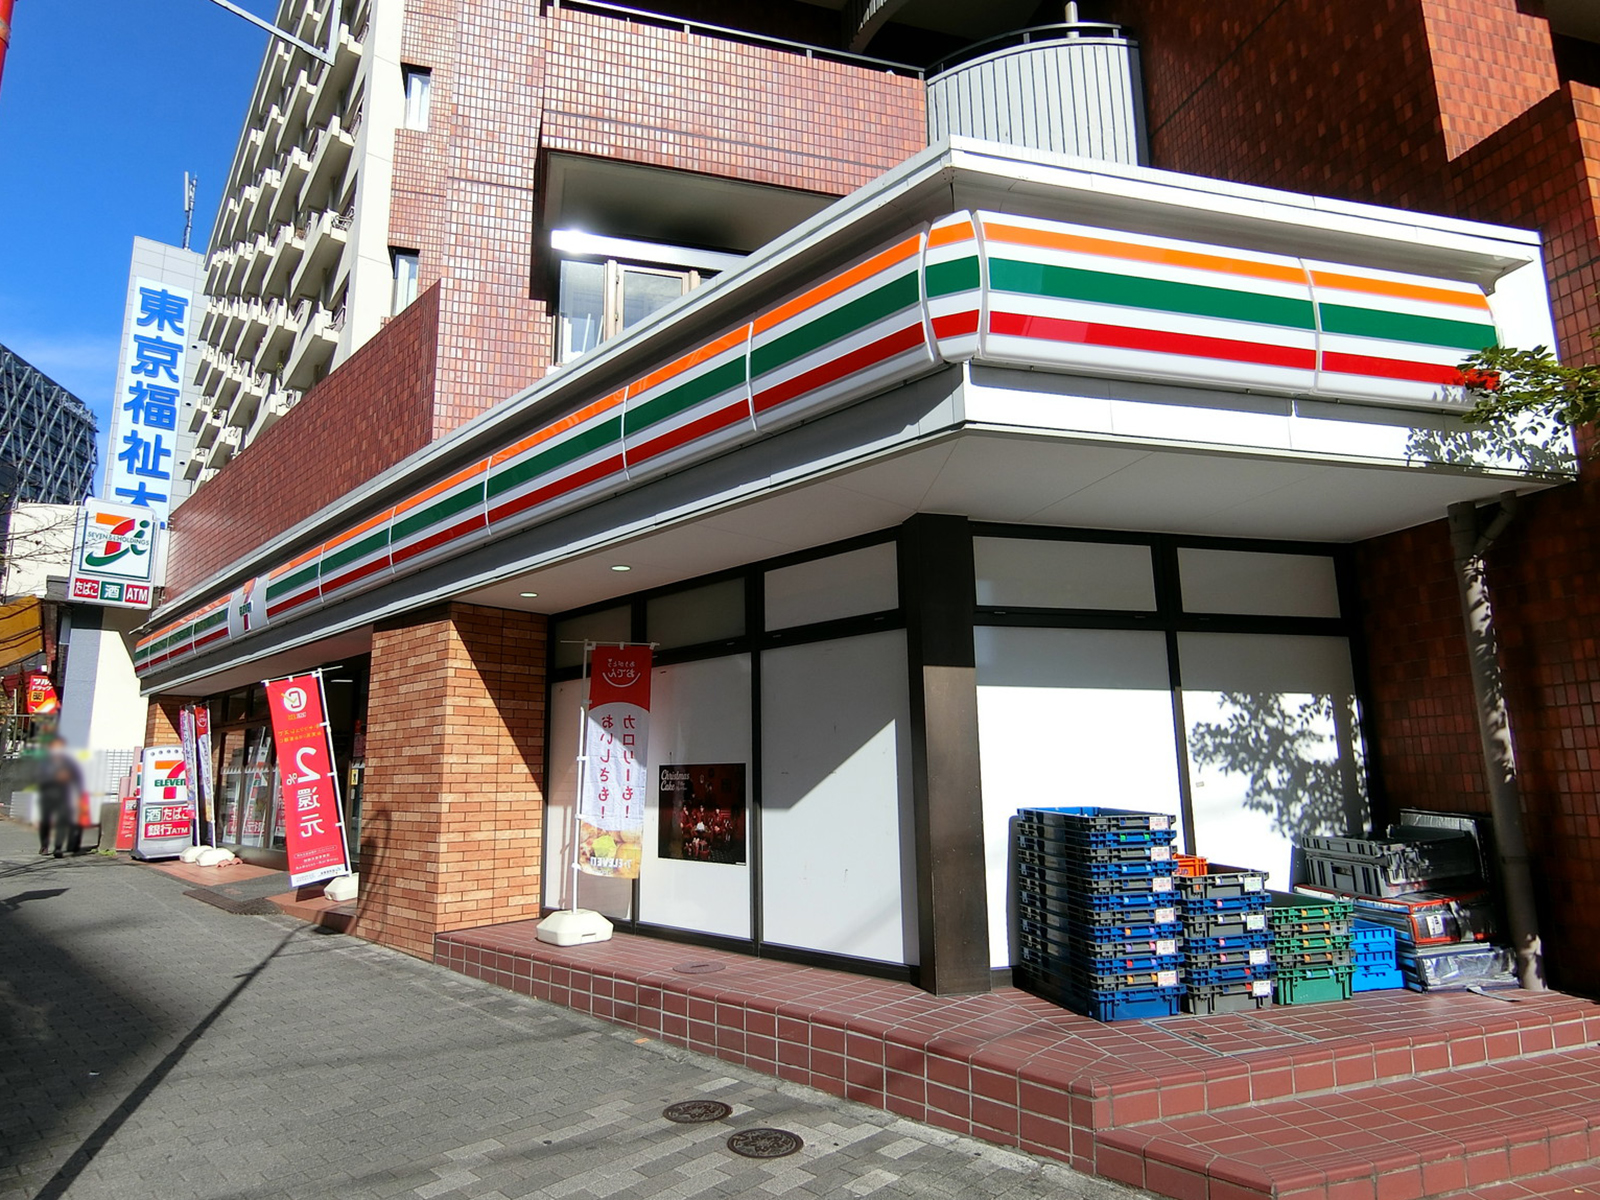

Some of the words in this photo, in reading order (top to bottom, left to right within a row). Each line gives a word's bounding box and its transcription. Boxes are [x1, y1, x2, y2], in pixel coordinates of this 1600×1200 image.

[75, 581, 98, 595] たばこ
[104, 584, 120, 598] 酒
[127, 588, 148, 601] ATM
[661, 769, 690, 780] Christmas
[660, 780, 675, 791] Cake
[146, 808, 161, 822] 酒
[163, 807, 190, 820] たばこ
